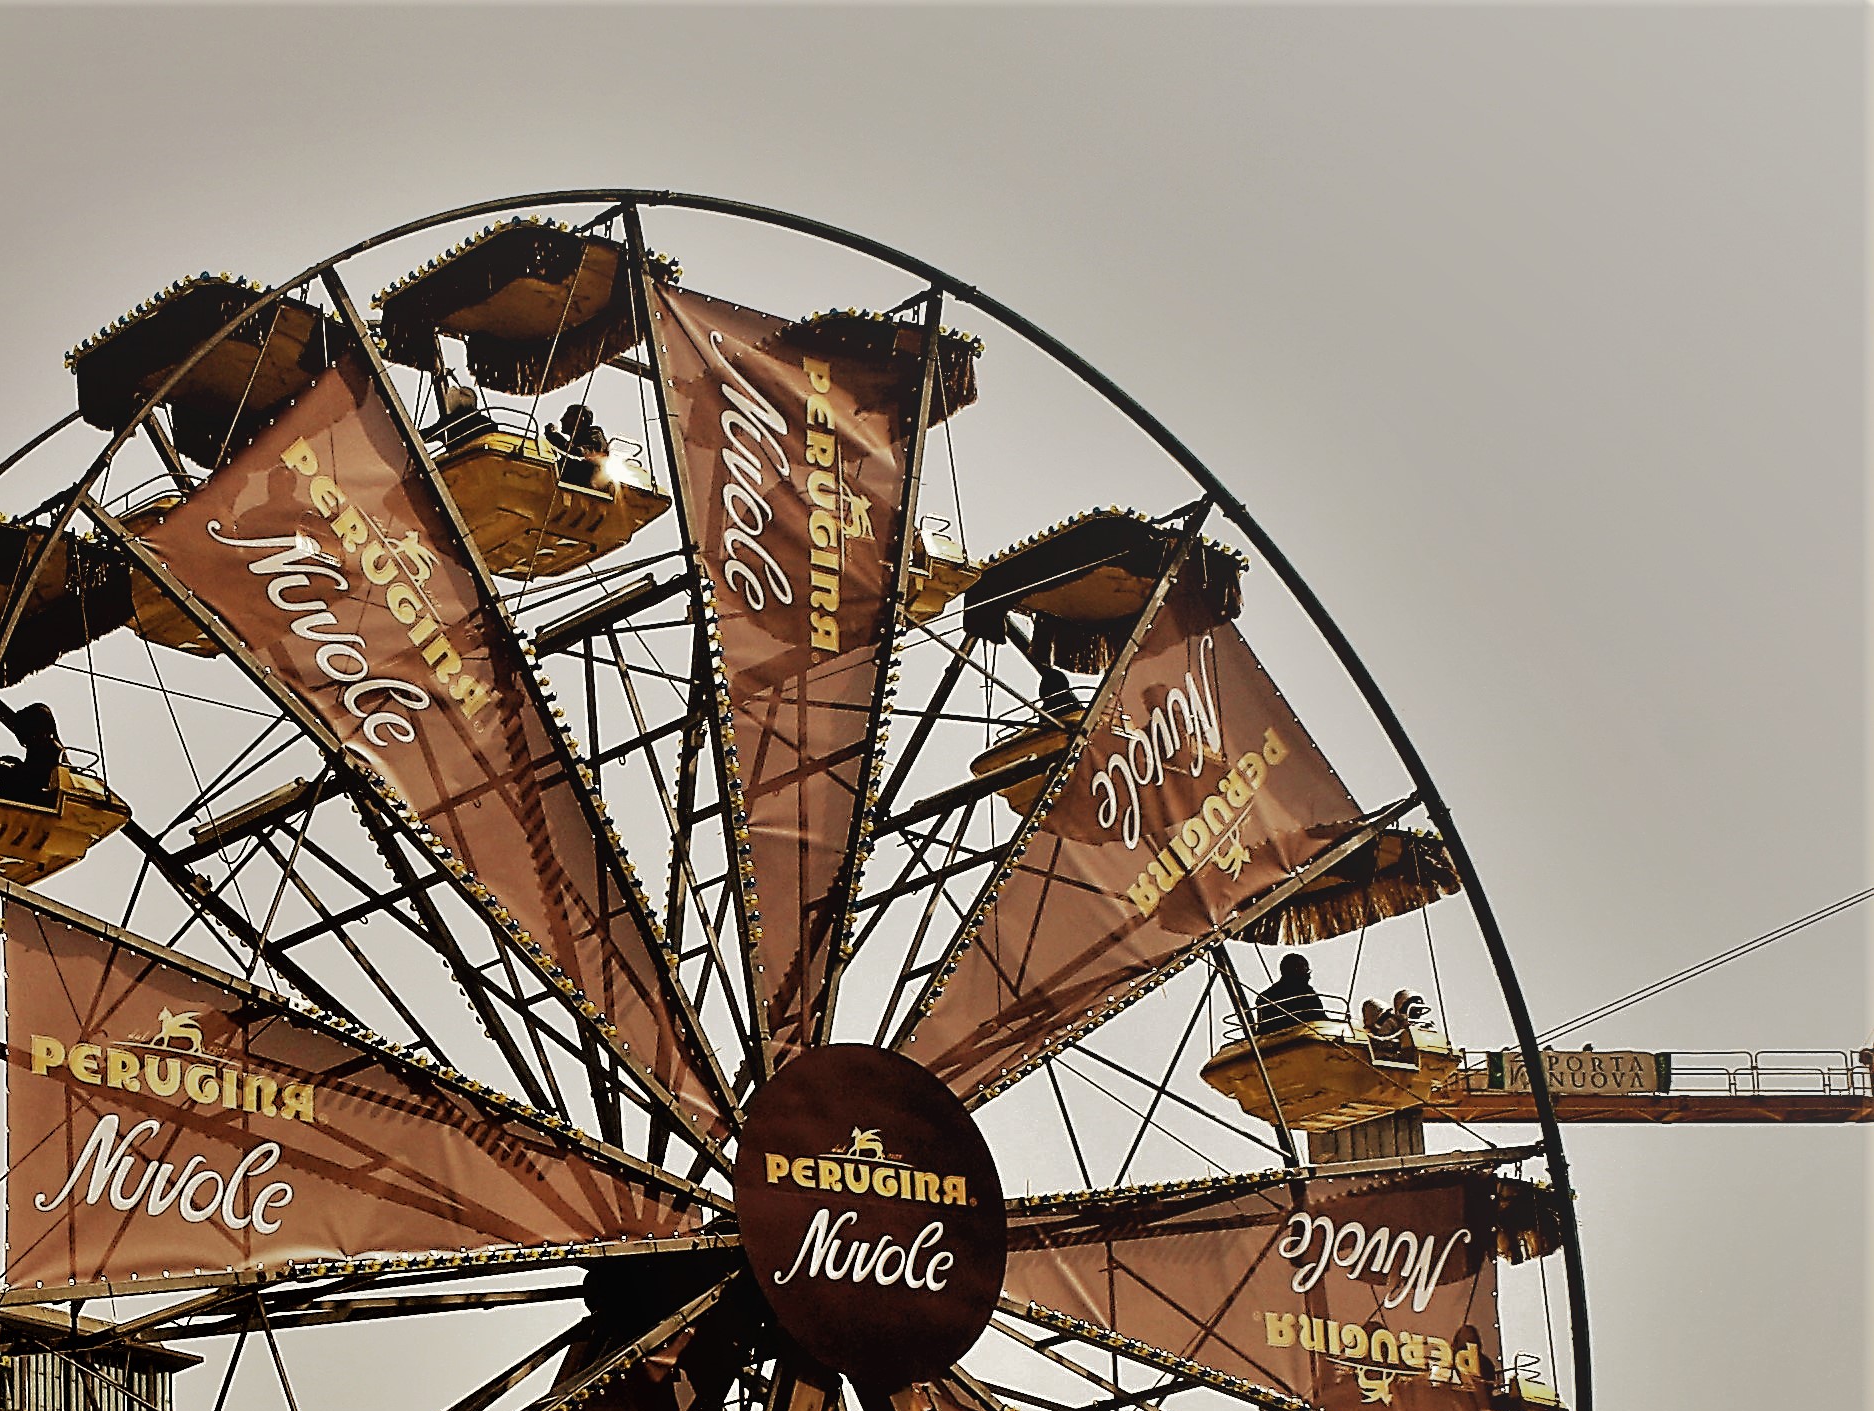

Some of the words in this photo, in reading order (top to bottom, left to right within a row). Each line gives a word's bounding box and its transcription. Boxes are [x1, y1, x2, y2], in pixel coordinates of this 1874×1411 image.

[710, 330, 793, 611] Nuvole
[803, 356, 841, 654] PERUGINA
[206, 519, 432, 747] Nuvole
[280, 436, 492, 720] PERUGINA
[1091, 635, 1221, 850] Nuvole
[1126, 728, 1289, 918] PERUGINA
[30, 1034, 316, 1123] PERUGINA
[1547, 1055, 1644, 1073] PORTA
[1547, 1071, 1645, 1088] NUOVA
[34, 1114, 294, 1235] Nuvole
[764, 1152, 967, 1206] PERUGINA
[774, 1208, 954, 1291] Nuvole
[1279, 1212, 1471, 1312] Nuvole
[1264, 1312, 1480, 1373] PERUGINA
